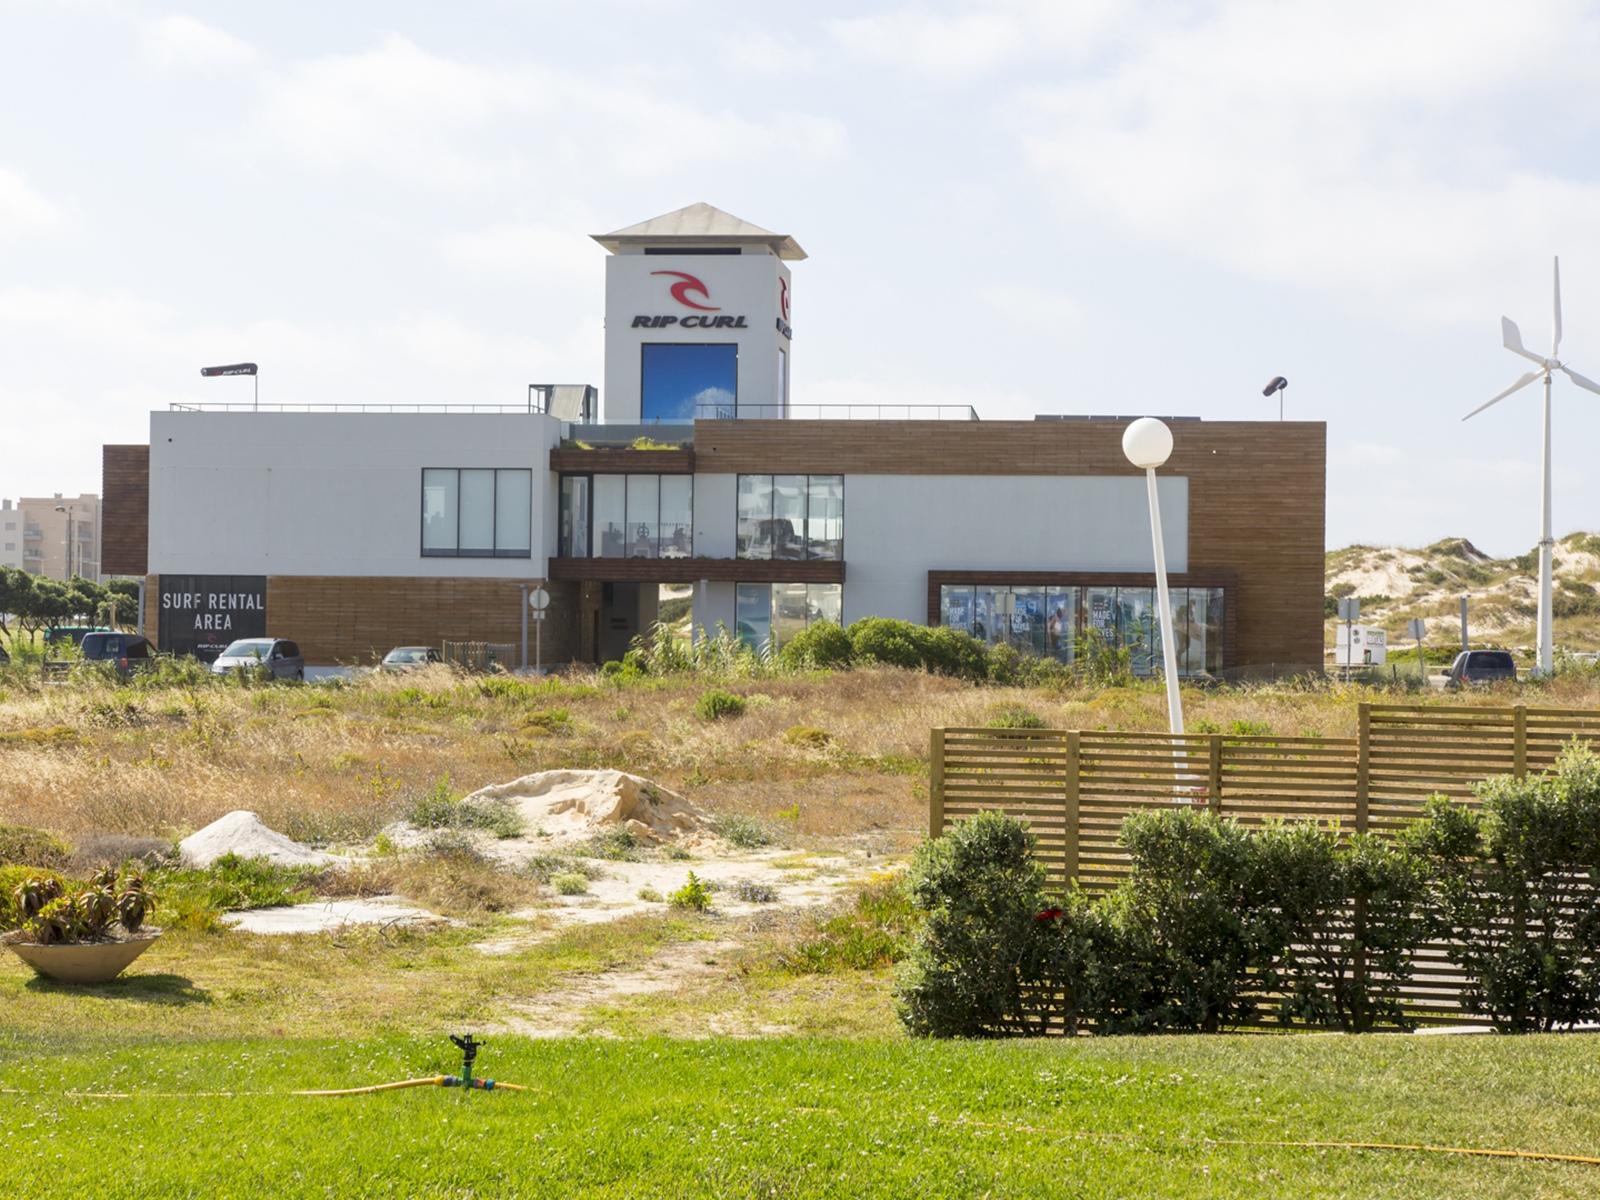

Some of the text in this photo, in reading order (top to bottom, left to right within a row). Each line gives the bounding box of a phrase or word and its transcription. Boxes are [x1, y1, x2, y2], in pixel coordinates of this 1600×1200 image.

[631, 315, 748, 329] RIP CURL
[163, 592, 264, 610] SURF RENTAL
[194, 613, 232, 630] AREA
[1092, 610, 1111, 620] MADE
